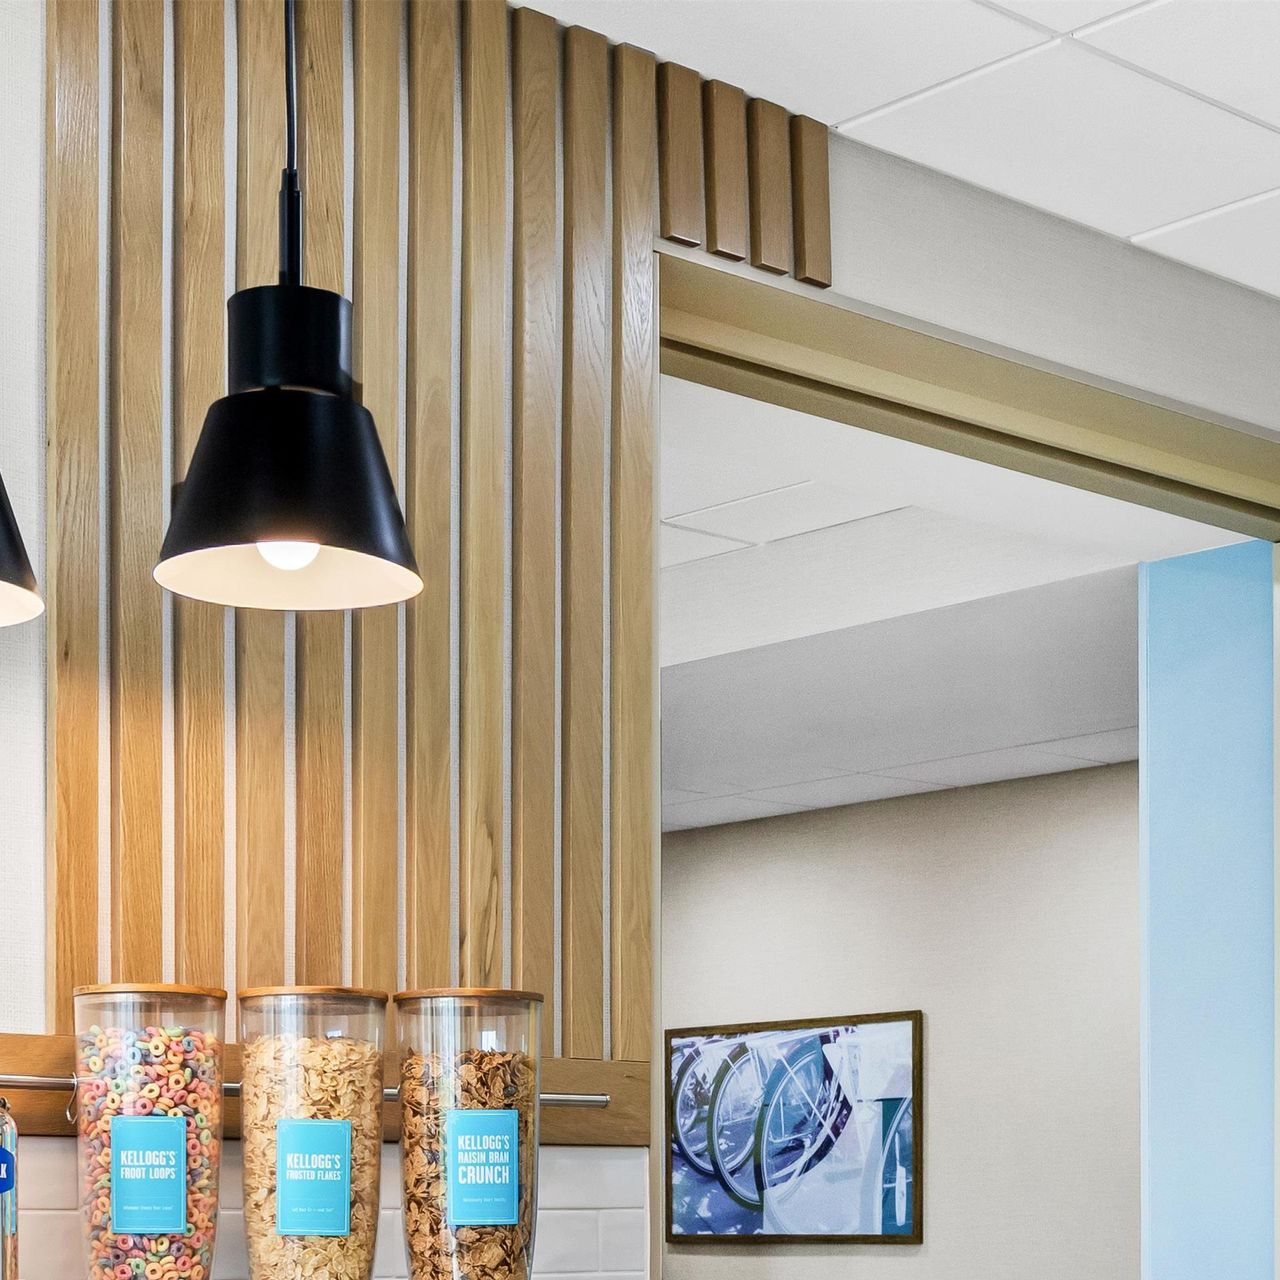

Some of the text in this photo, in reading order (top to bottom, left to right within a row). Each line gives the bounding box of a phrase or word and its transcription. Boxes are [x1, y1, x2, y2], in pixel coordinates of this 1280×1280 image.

[458, 1135, 510, 1150] KELLOGG'S
[120, 1150, 176, 1166] KELLOGG'S
[286, 1153, 341, 1169] KELLOGG'S
[458, 1151, 509, 1163] RAISIN BRAN
[120, 1167, 176, 1179] FROOT LOOPS
[286, 1169, 342, 1181] FROSTED FLAKES
[458, 1165, 510, 1184] CRUNCH
